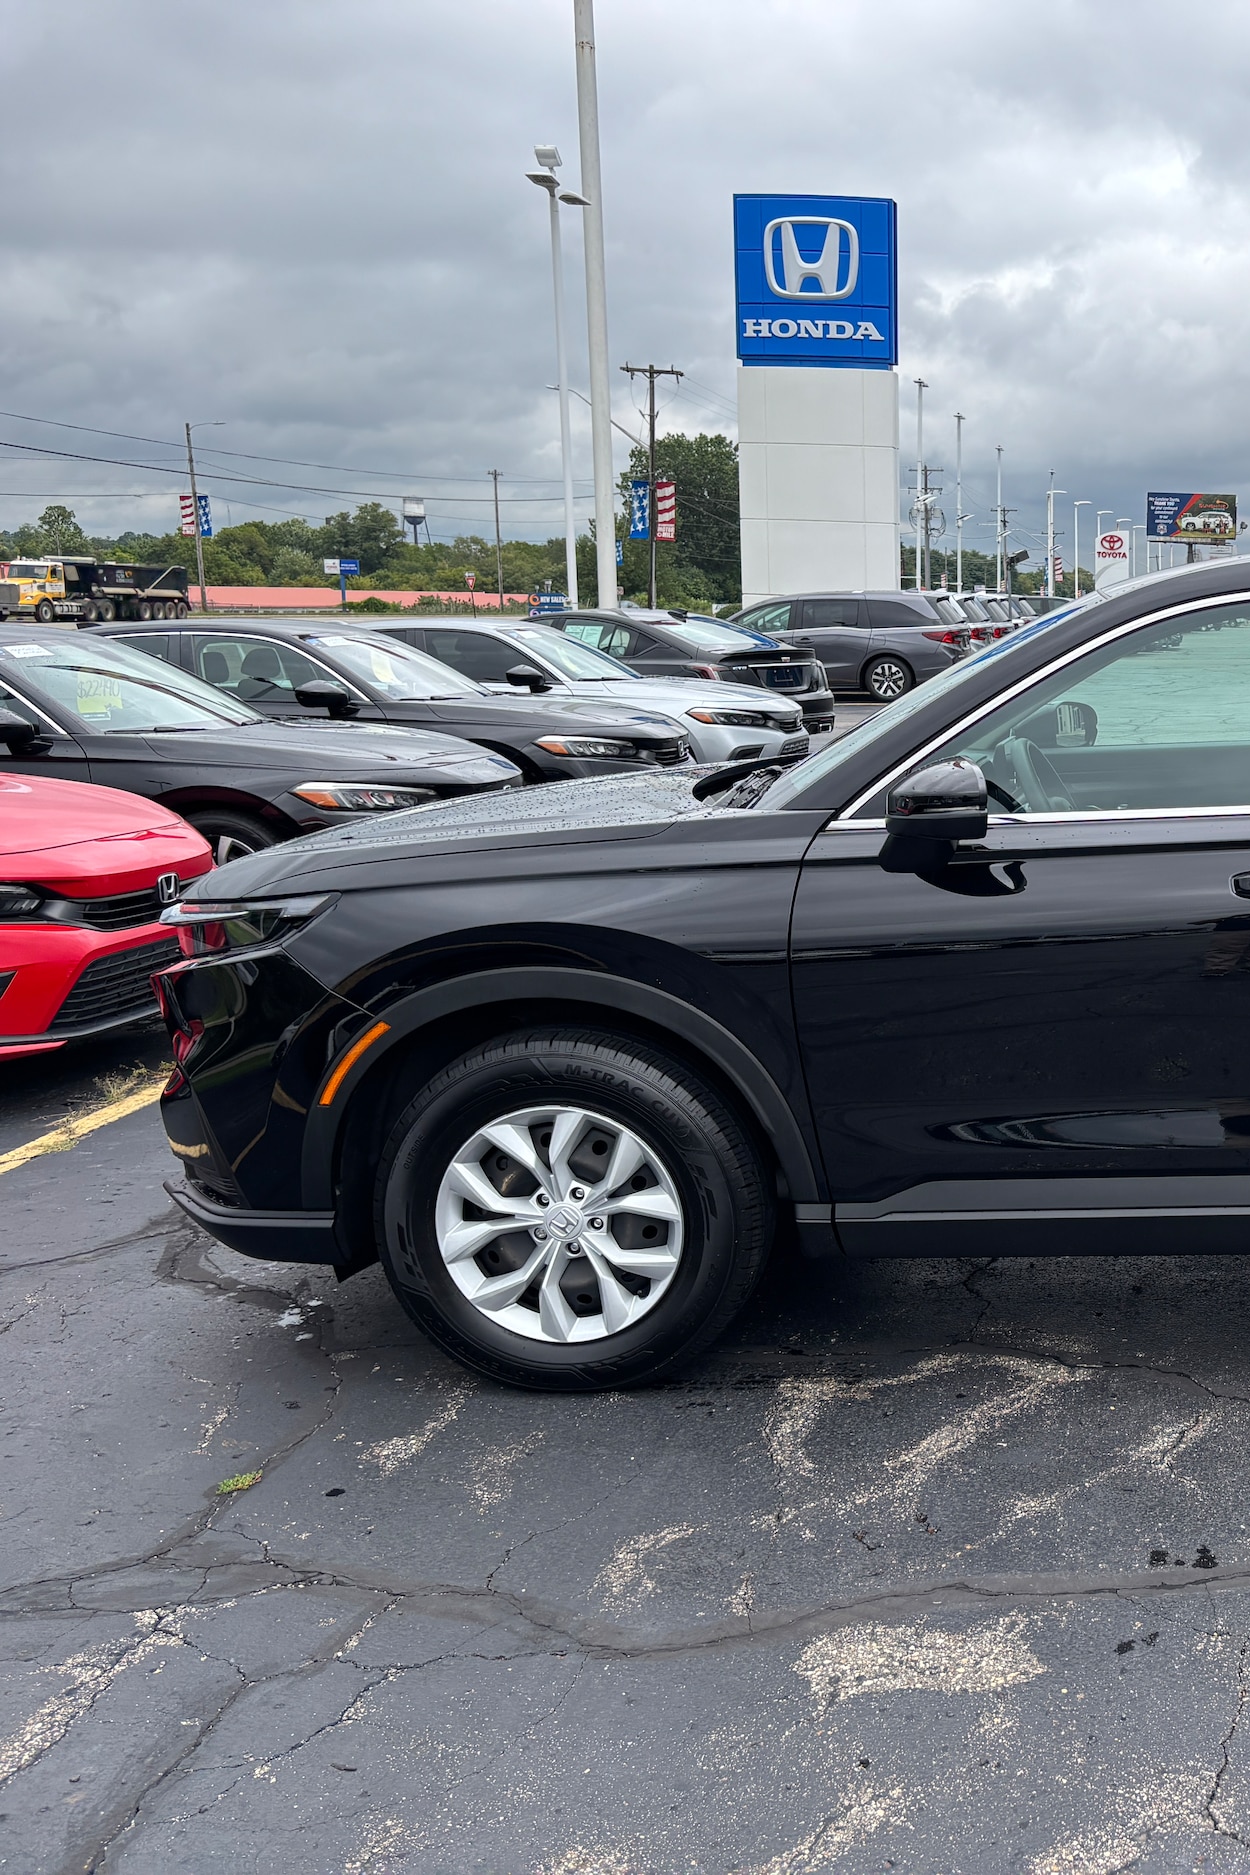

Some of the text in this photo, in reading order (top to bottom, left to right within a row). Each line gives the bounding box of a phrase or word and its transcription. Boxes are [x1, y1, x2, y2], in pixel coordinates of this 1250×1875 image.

[743, 319, 885, 341] HONDA
[1097, 551, 1127, 559] TOYOTA
[565, 1064, 644, 1098] M-TRAC
[403, 1134, 425, 1170] OUTSIDE
